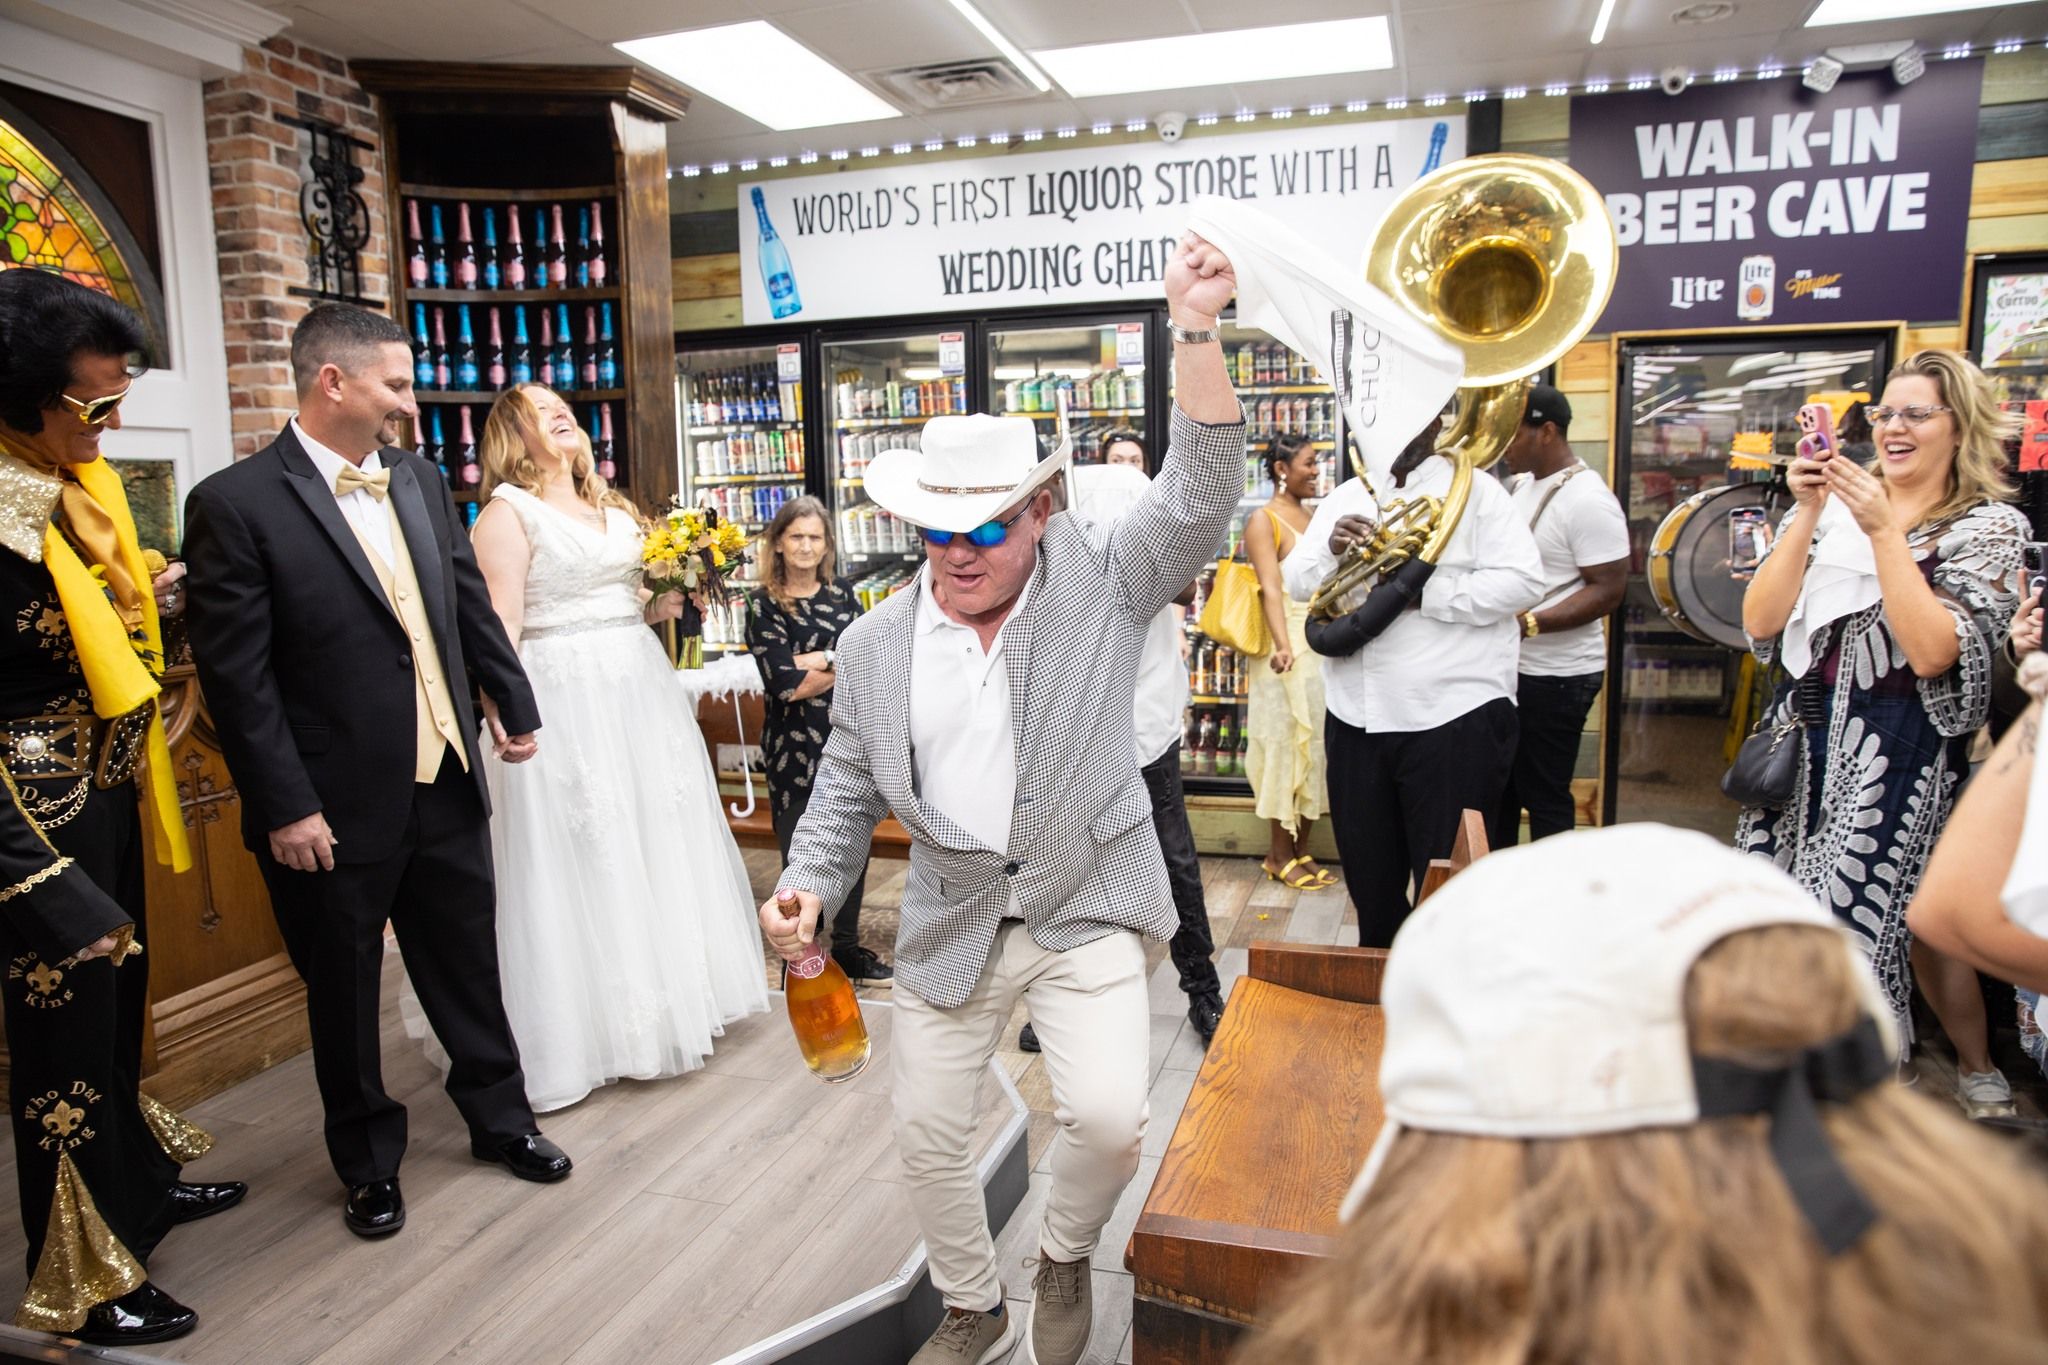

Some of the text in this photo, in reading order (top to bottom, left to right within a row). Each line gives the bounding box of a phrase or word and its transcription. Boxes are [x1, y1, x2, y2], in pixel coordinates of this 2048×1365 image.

[1634, 104, 1901, 179] WALK-IN
[792, 144, 1393, 237] WORLD'S FIRST LIQUOR STORE WITH A
[1605, 172, 1930, 247] BEER CAVE
[939, 236, 1176, 296] WEDDING CHAP
[1745, 265, 1772, 282] Lite
[1669, 276, 1725, 310] Lite
[1360, 321, 1381, 429] CHUC
[16, 600, 41, 633] Who
[9, 951, 38, 979] Who
[25, 1081, 103, 1119] Who Dat
[38, 1126, 96, 1151] King
